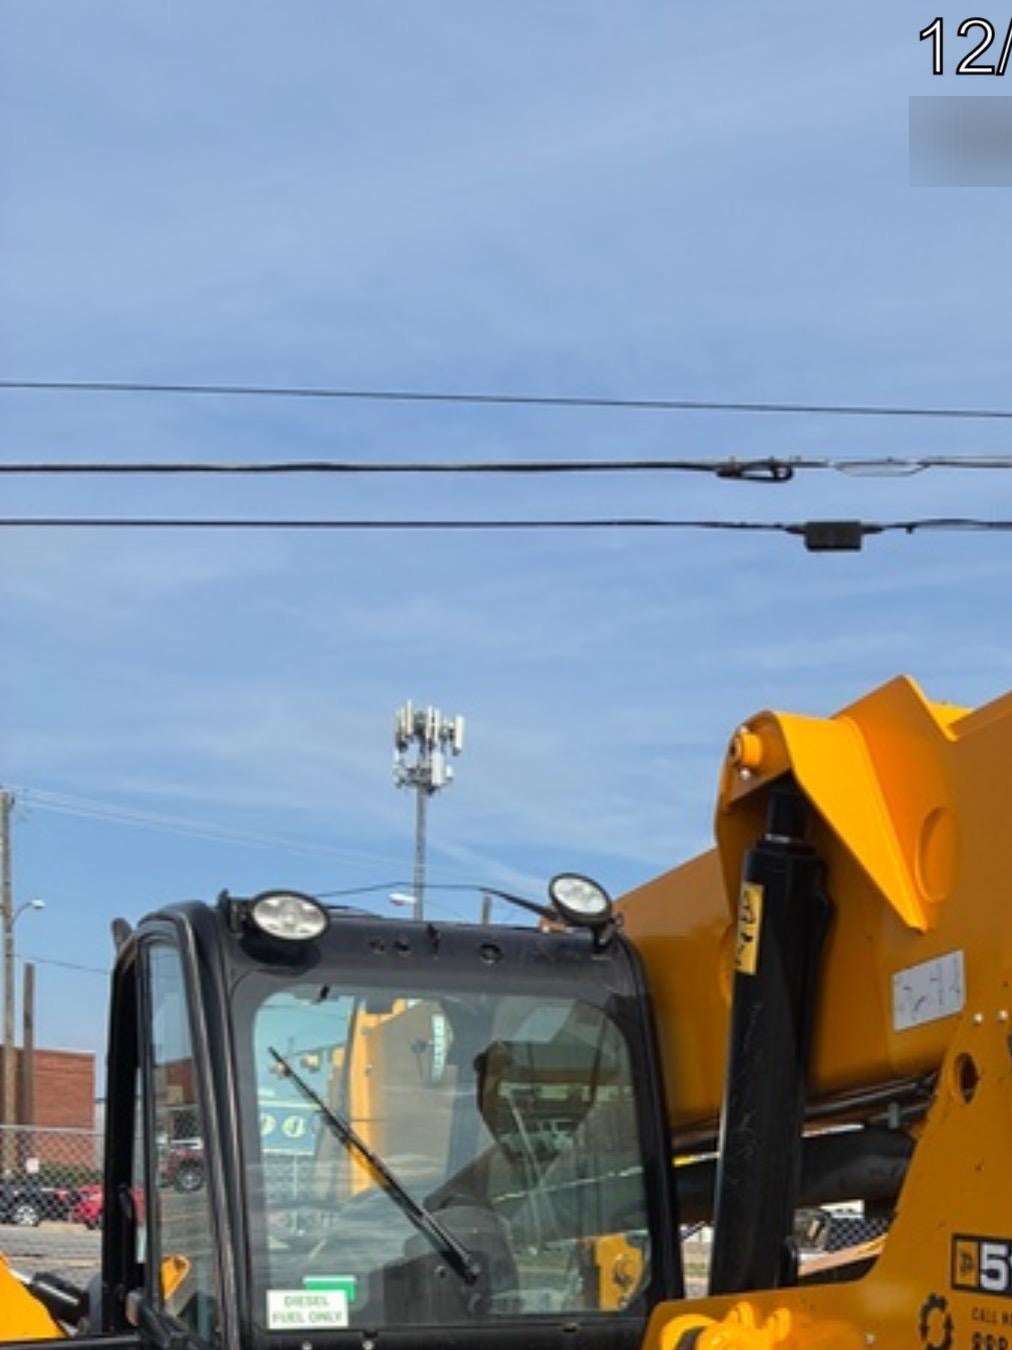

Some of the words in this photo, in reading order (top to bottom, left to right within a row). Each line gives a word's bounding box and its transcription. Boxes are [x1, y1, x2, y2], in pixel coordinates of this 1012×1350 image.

[284, 1295, 330, 1308] DIESEL
[272, 1311, 305, 1324] FUEL
[308, 1310, 342, 1324] ONLY
[971, 1306, 997, 1325] CALL
